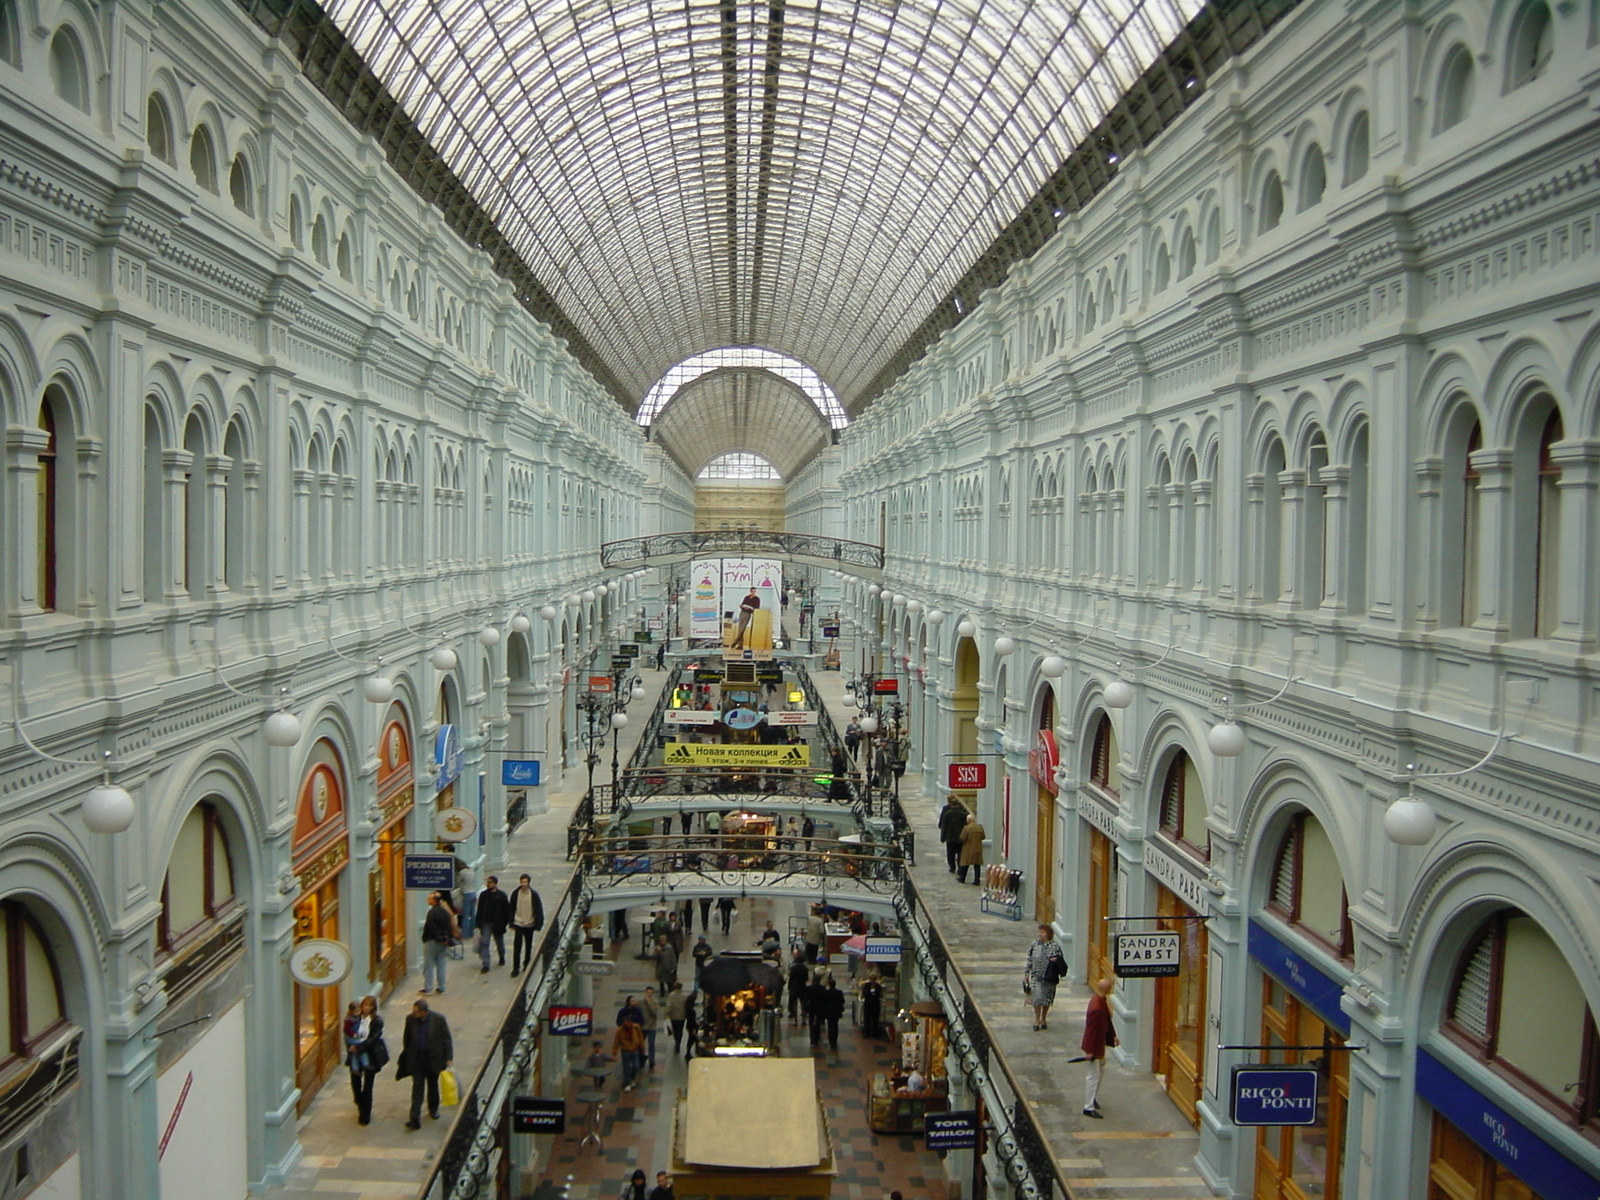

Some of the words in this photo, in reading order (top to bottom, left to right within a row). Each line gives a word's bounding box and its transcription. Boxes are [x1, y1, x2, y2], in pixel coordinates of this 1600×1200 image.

[696, 747, 725, 756] Новая
[728, 747, 778, 758] коллекция
[667, 756, 695, 764] adidas
[778, 758, 807, 766] adidas
[405, 861, 451, 869] PIONEER
[1146, 848, 1175, 886] SANDRA
[1120, 938, 1177, 948] SANDRA
[1123, 949, 1173, 960] PABST
[1240, 1087, 1285, 1099] RICO
[1261, 1097, 1312, 1109] PONTI
[934, 1120, 968, 1128] TOM
[1483, 1111, 1505, 1136] RICO
[928, 1129, 975, 1138] TAILOR
[1492, 1131, 1518, 1160] PONTI
